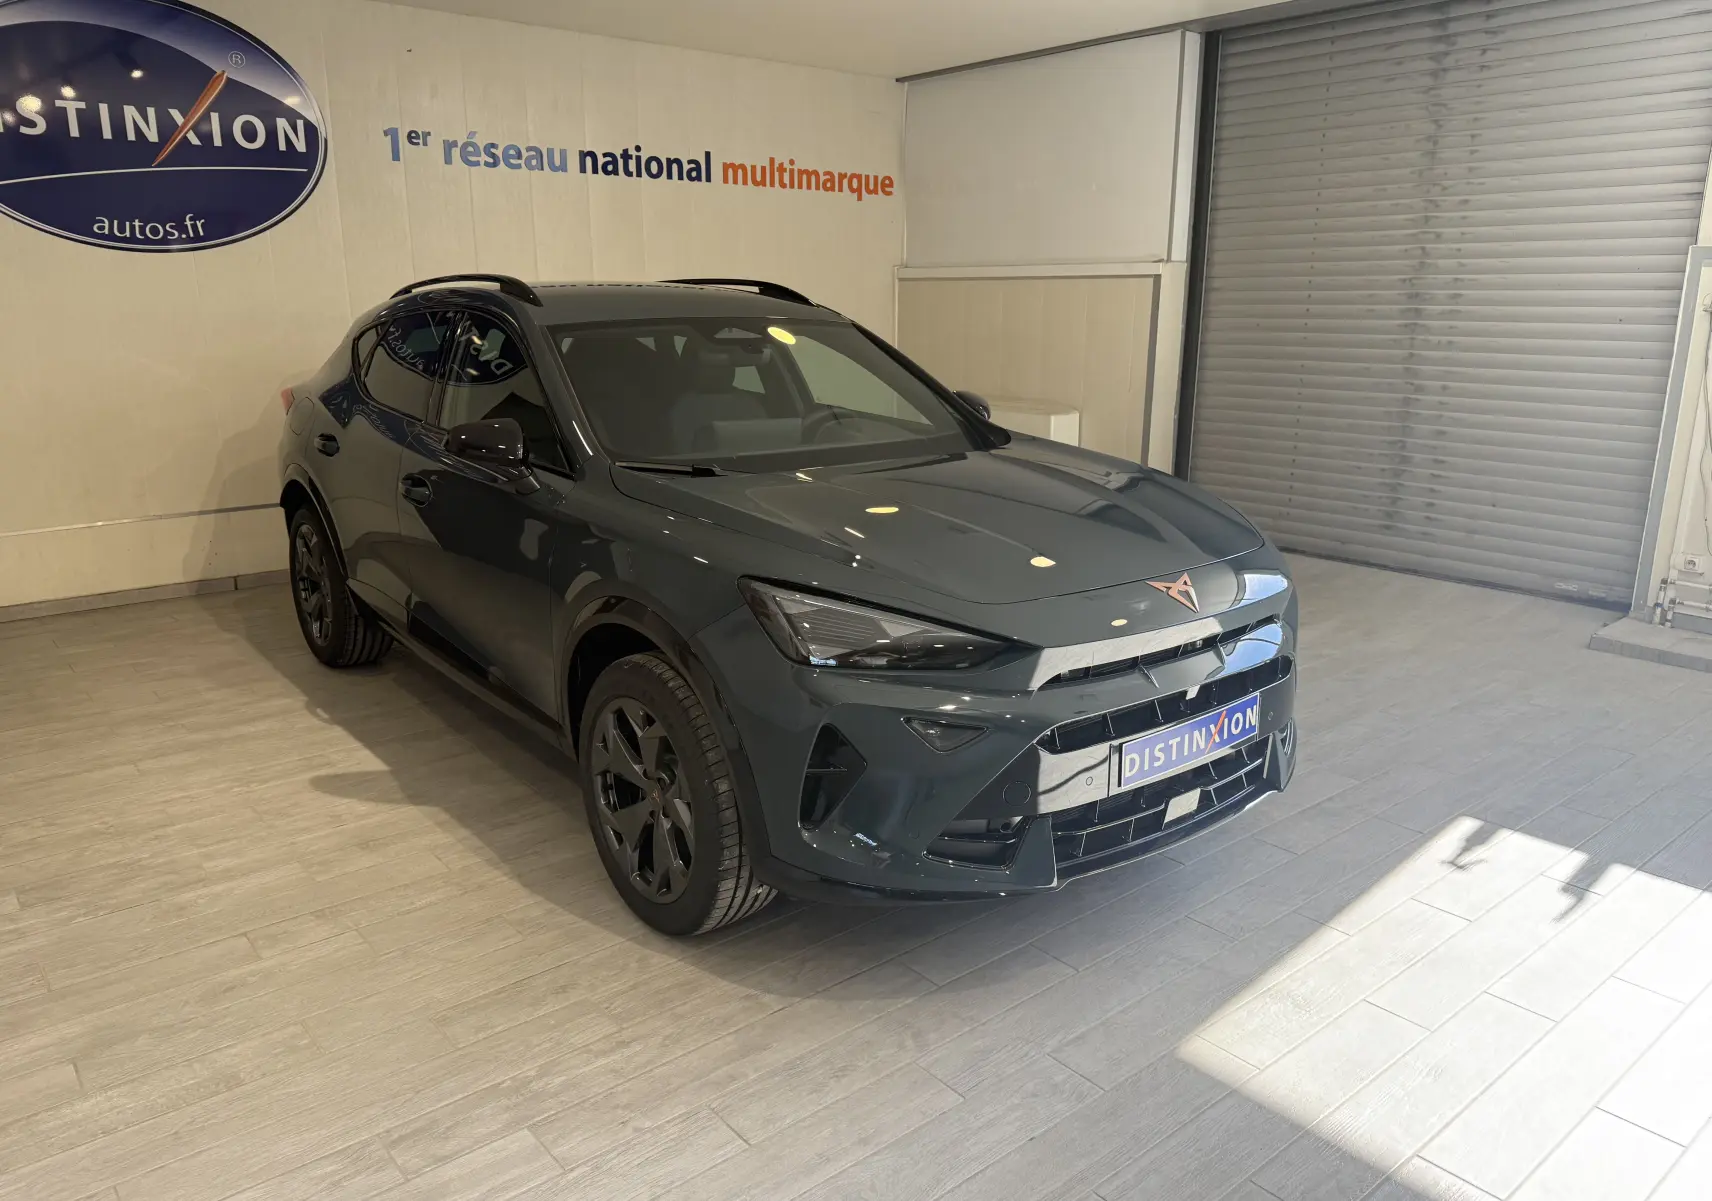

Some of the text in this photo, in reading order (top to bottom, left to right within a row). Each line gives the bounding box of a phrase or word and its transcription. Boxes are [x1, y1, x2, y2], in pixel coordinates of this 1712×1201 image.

[442, 131, 568, 173] réseau
[578, 145, 711, 183] national
[721, 156, 894, 201] multimarque
[93, 214, 205, 240] autos.fr
[1124, 704, 1256, 778] DISTINXION
